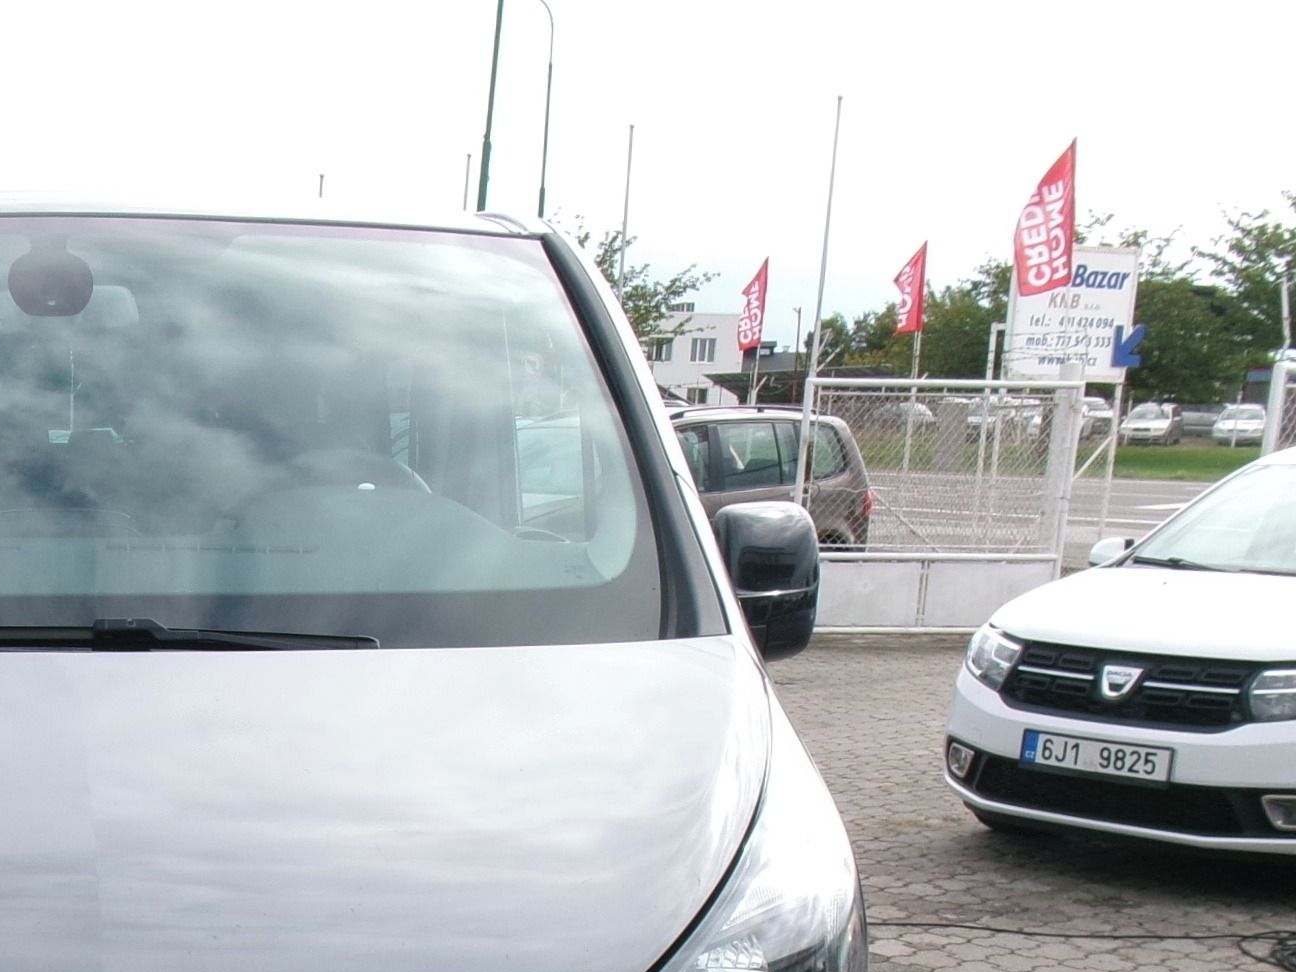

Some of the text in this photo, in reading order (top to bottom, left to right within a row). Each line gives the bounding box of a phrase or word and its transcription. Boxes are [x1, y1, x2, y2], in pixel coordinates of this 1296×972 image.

[1071, 264, 1131, 290] Bazar
[1041, 738, 1158, 776] 6J1 9825
